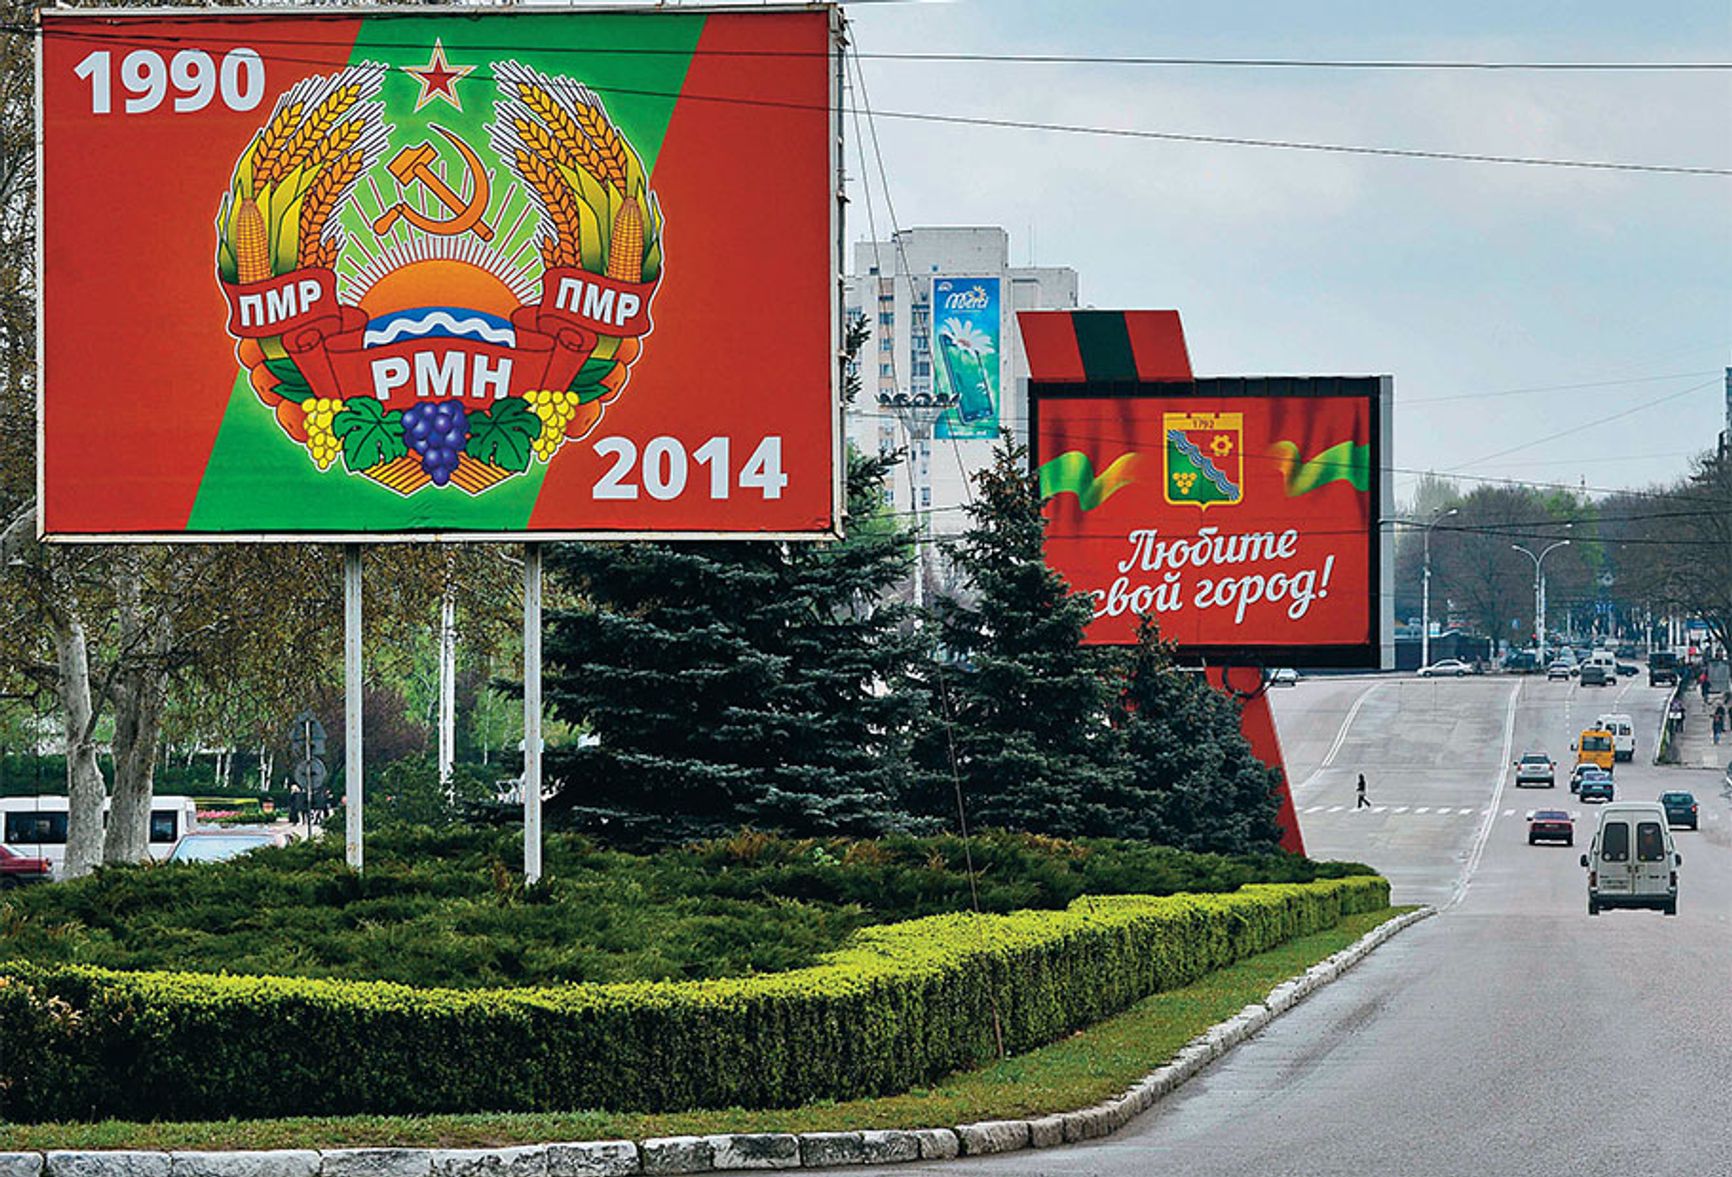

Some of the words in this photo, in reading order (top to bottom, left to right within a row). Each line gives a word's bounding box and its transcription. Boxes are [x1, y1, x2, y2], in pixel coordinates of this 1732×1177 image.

[73, 47, 266, 114] 1990
[239, 279, 323, 327] ПМР
[555, 277, 641, 327] ПМР
[371, 350, 513, 401] РМН
[592, 435, 788, 501] 2014
[1117, 526, 1298, 574] Любите
[1194, 554, 1335, 624] город!
